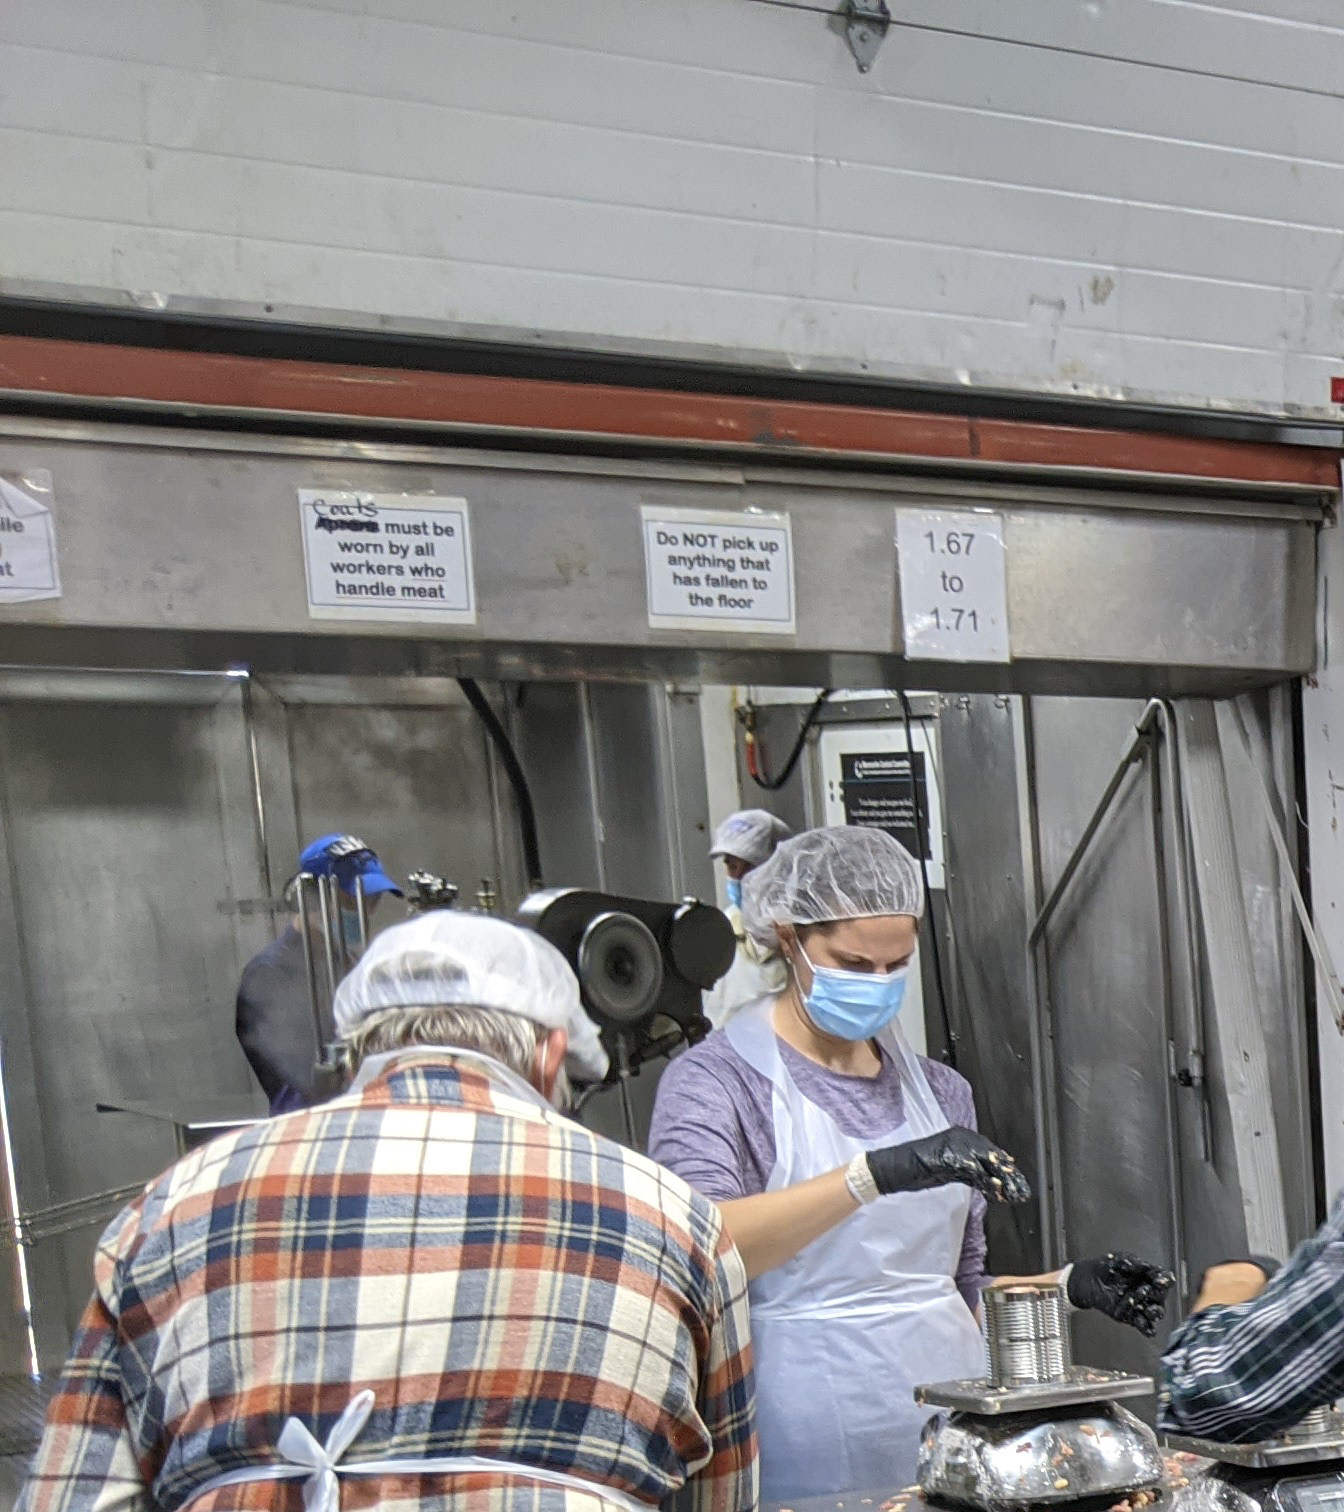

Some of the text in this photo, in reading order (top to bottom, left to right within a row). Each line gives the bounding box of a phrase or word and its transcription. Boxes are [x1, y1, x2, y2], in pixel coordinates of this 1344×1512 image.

[312, 498, 378, 517] Coats
[385, 522, 429, 536] must
[433, 521, 455, 537] be
[338, 541, 435, 559] worn by all
[656, 531, 779, 555] Do NOT pick up
[924, 530, 975, 556] 1.67
[330, 560, 446, 578] workers who
[668, 554, 771, 573] anything that
[335, 580, 445, 599] handle meat
[673, 573, 768, 591] has fallen to
[940, 570, 964, 593] to
[688, 593, 754, 609] the floor
[930, 606, 978, 632] 1.71
